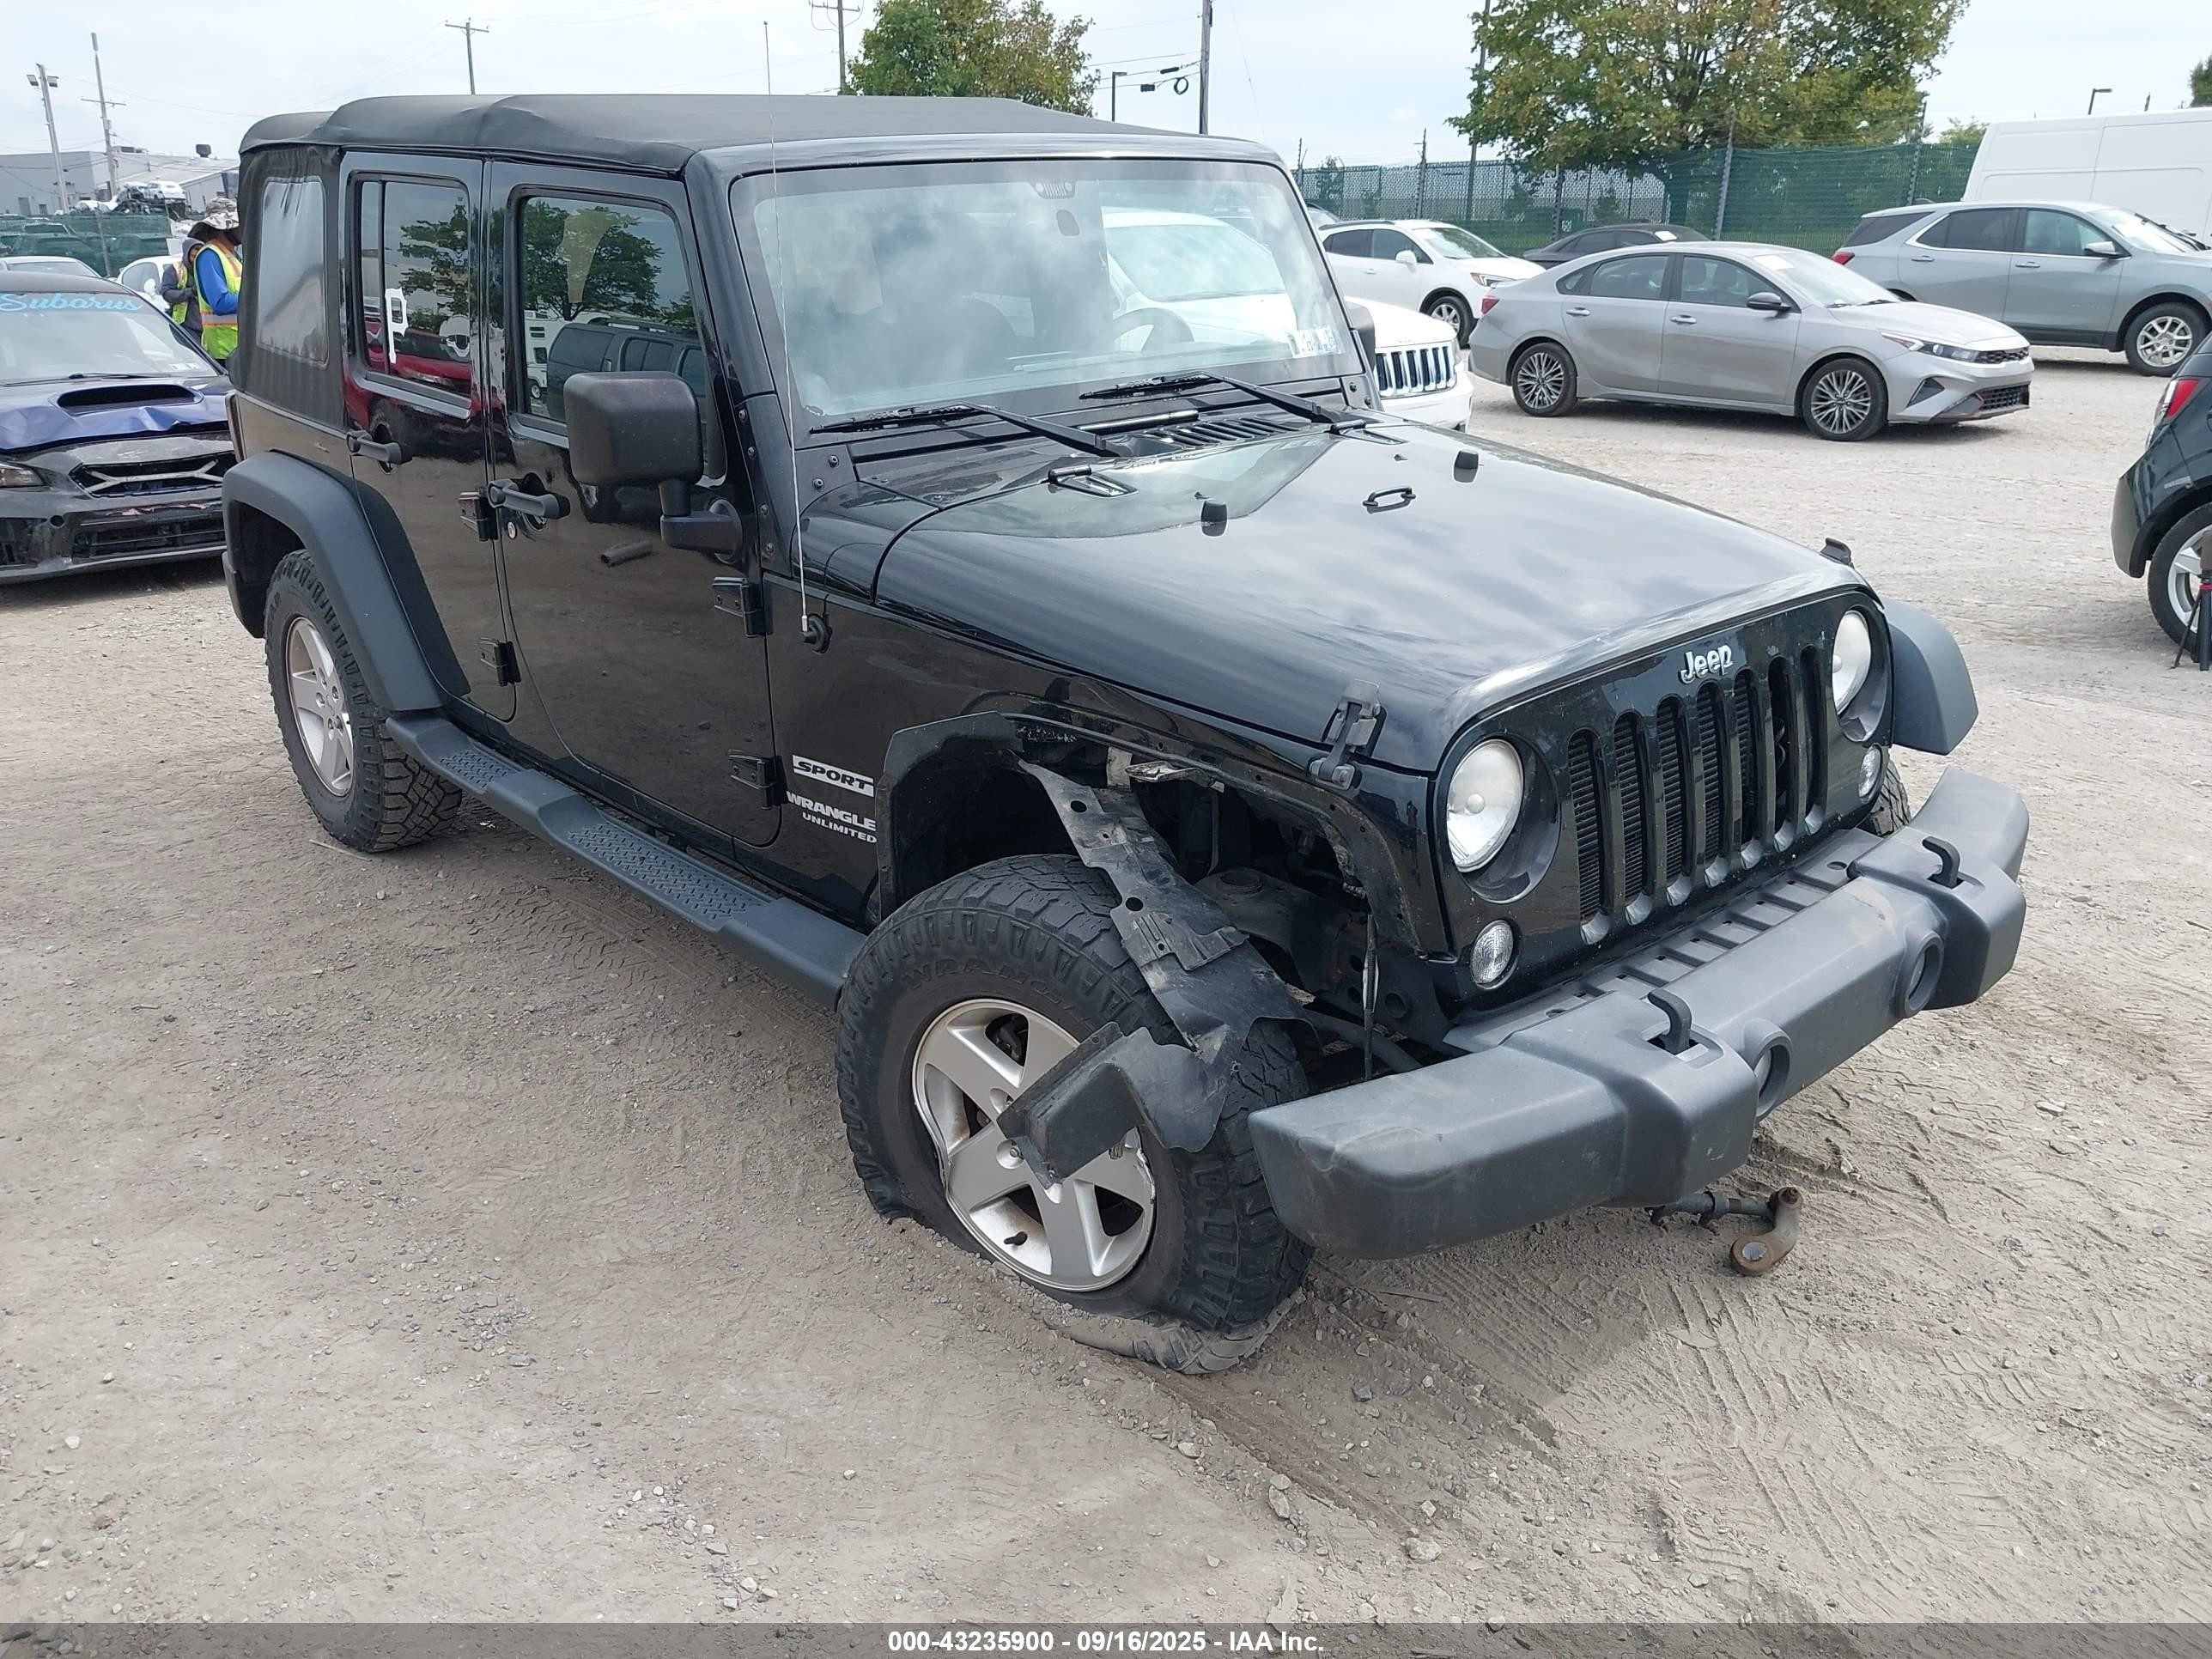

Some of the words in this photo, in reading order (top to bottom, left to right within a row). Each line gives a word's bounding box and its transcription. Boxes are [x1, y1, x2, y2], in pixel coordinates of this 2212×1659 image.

[0, 293, 143, 312] Subarus
[1680, 645, 1733, 684] Jeep
[796, 759, 869, 791] SPORT
[786, 791, 877, 832] WRANGLE
[802, 811, 878, 843] UNLIMITED
